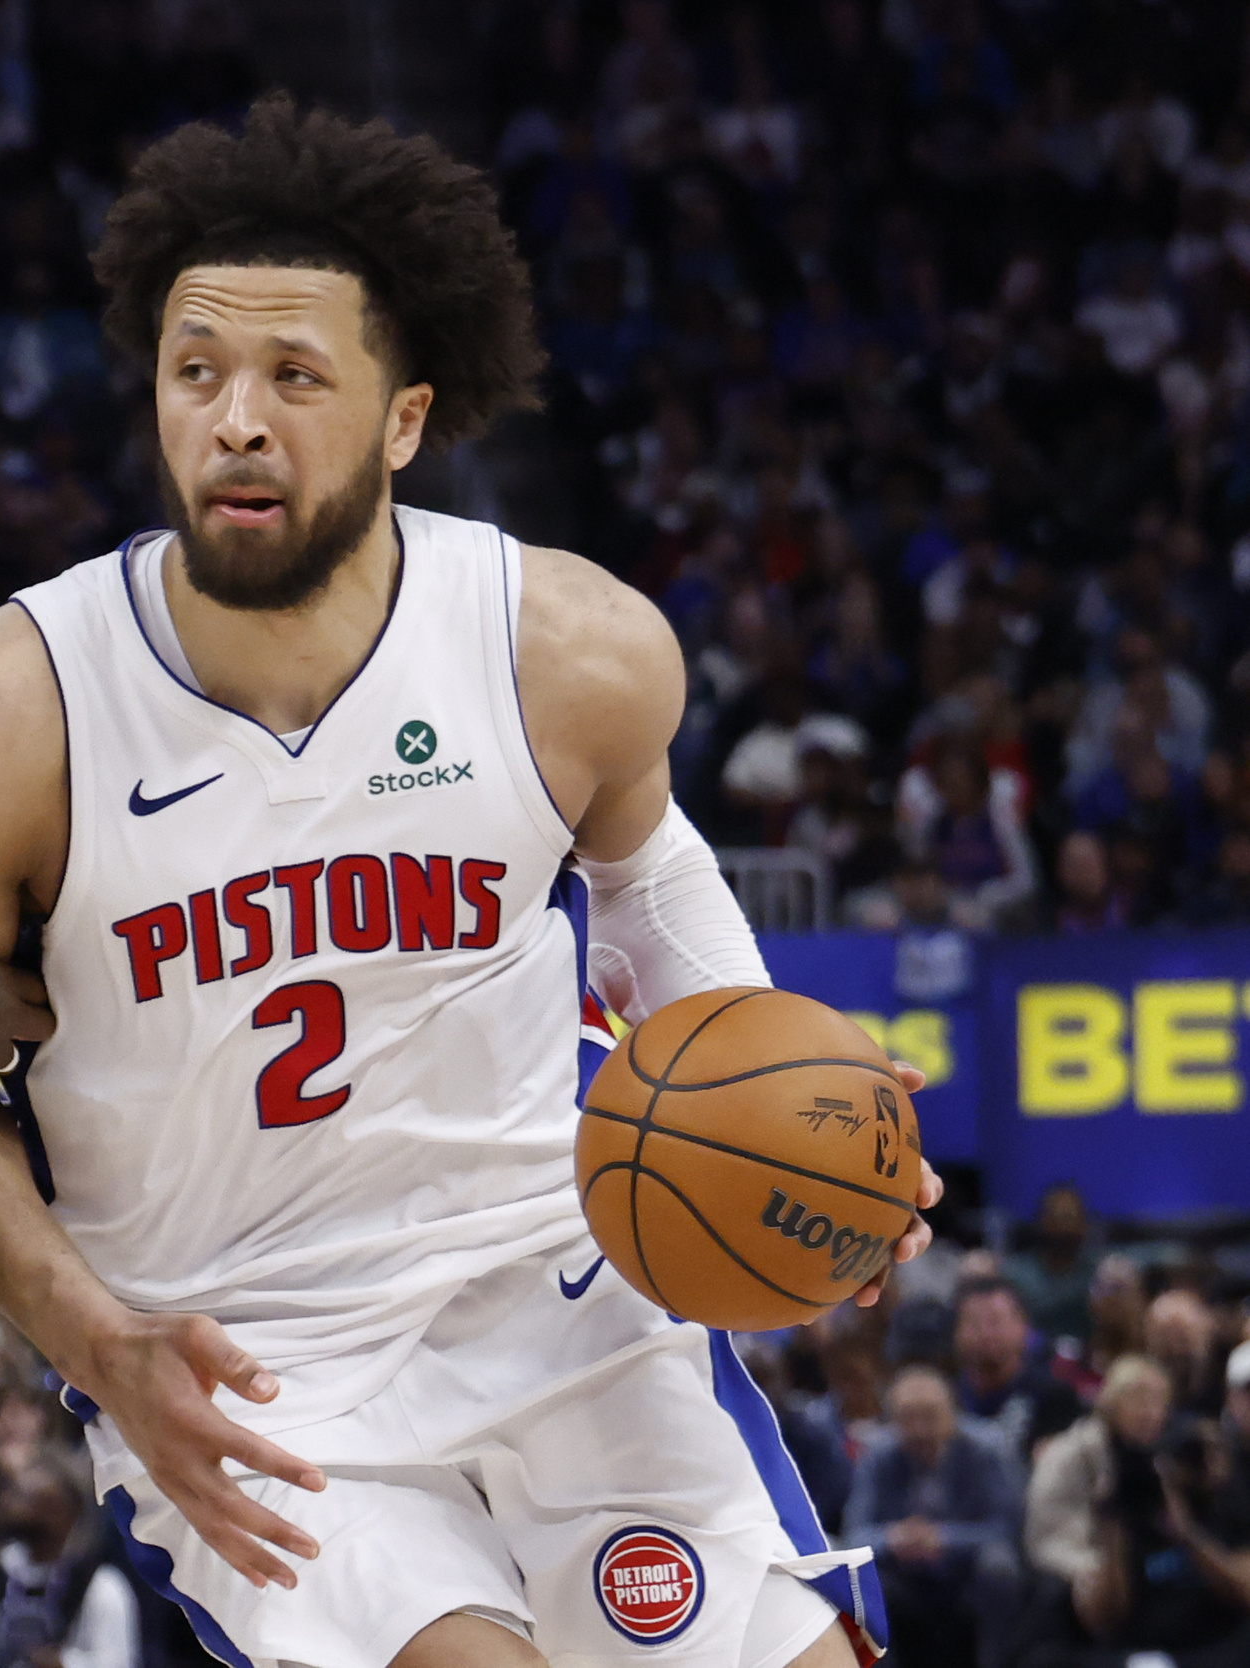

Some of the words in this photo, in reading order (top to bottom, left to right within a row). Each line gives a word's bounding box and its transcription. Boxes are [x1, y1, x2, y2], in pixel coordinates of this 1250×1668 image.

[368, 760, 474, 795] StockX
[112, 852, 507, 1004] PISTONS
[251, 979, 352, 1130] 2
[1018, 981, 1250, 1116] BE
[611, 1562, 679, 1587] DETROIT
[613, 1582, 683, 1606] PISTONS
